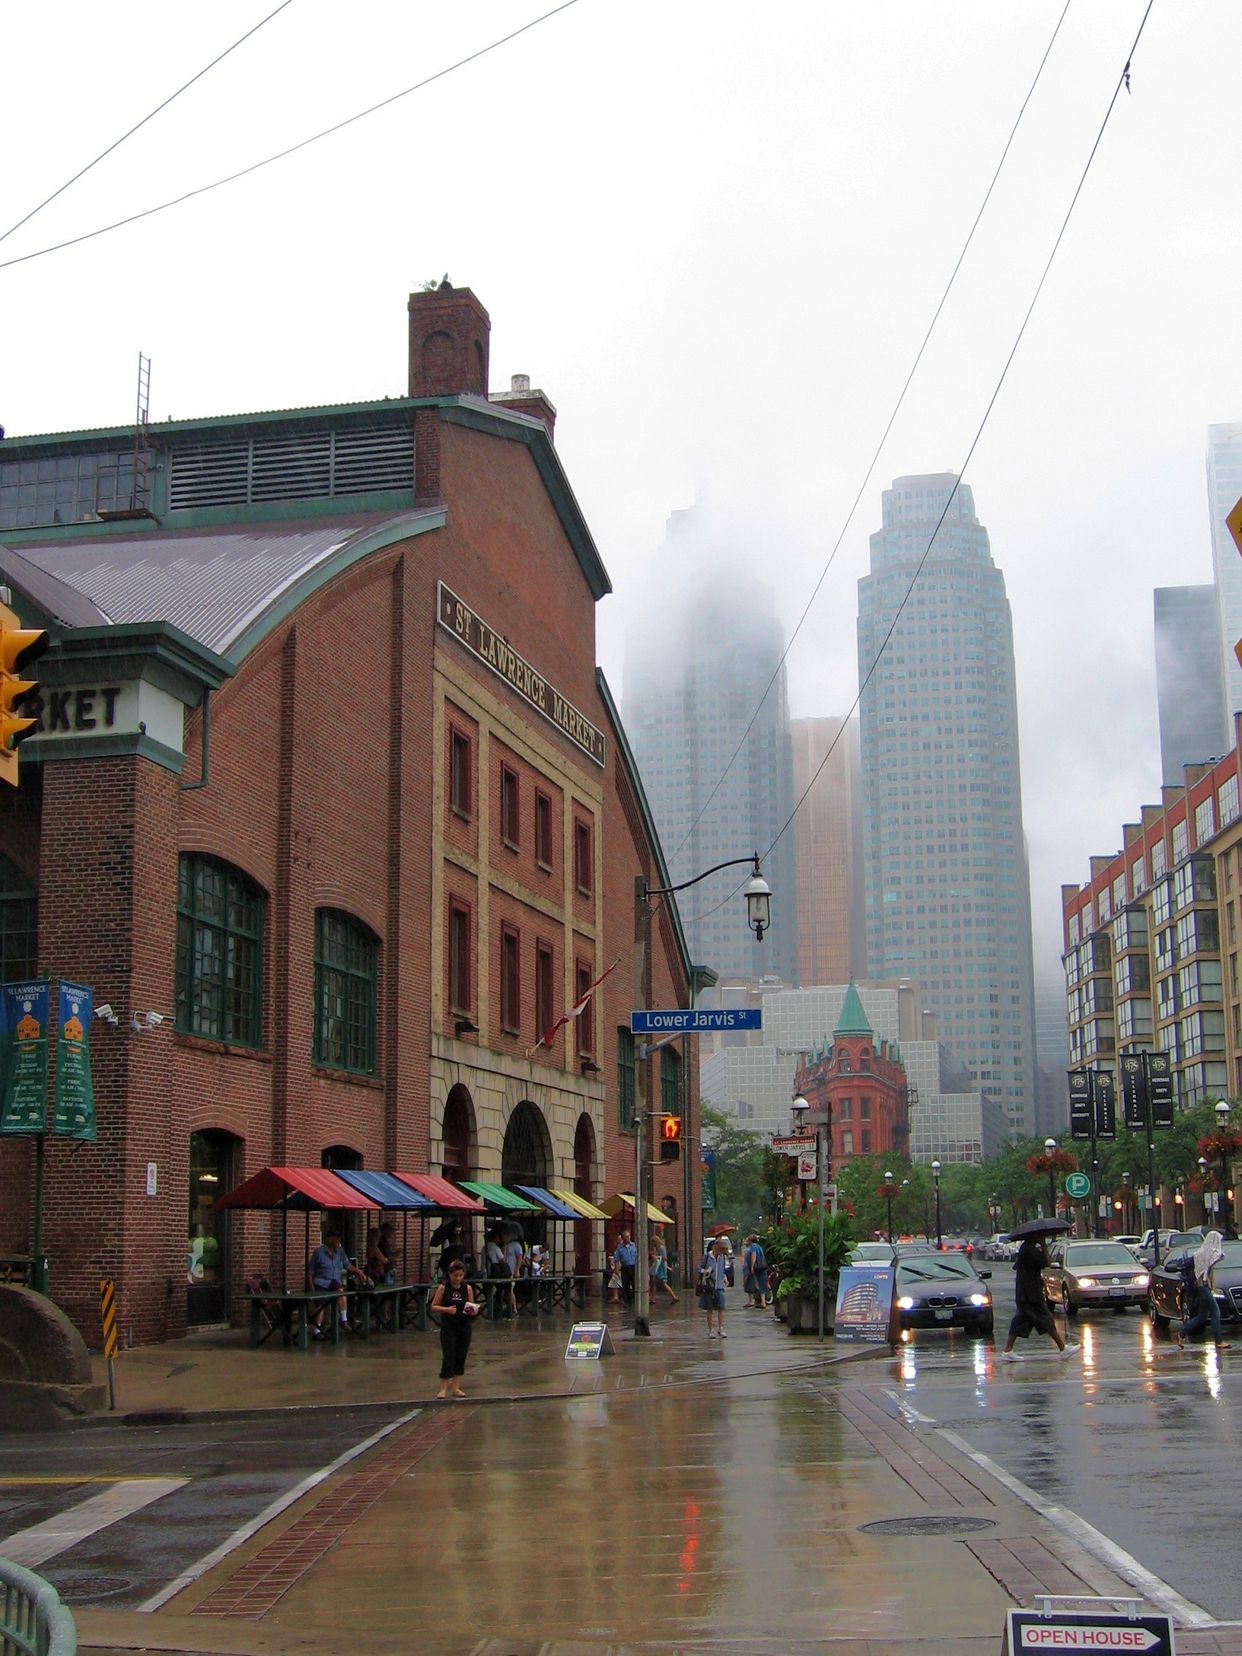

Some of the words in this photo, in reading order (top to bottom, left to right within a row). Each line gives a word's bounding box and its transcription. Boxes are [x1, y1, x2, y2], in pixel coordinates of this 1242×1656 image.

[479, 626, 546, 709] LAWRENCE
[553, 694, 596, 753] MARKET
[22, 687, 121, 733] RKET
[15, 993, 39, 1001] MARKET
[646, 1013, 688, 1028] Lower
[692, 1011, 735, 1027] Jarvis
[1072, 1176, 1085, 1190] P
[1026, 1628, 1078, 1644] OPEN
[1082, 1631, 1145, 1646] HOUSE
